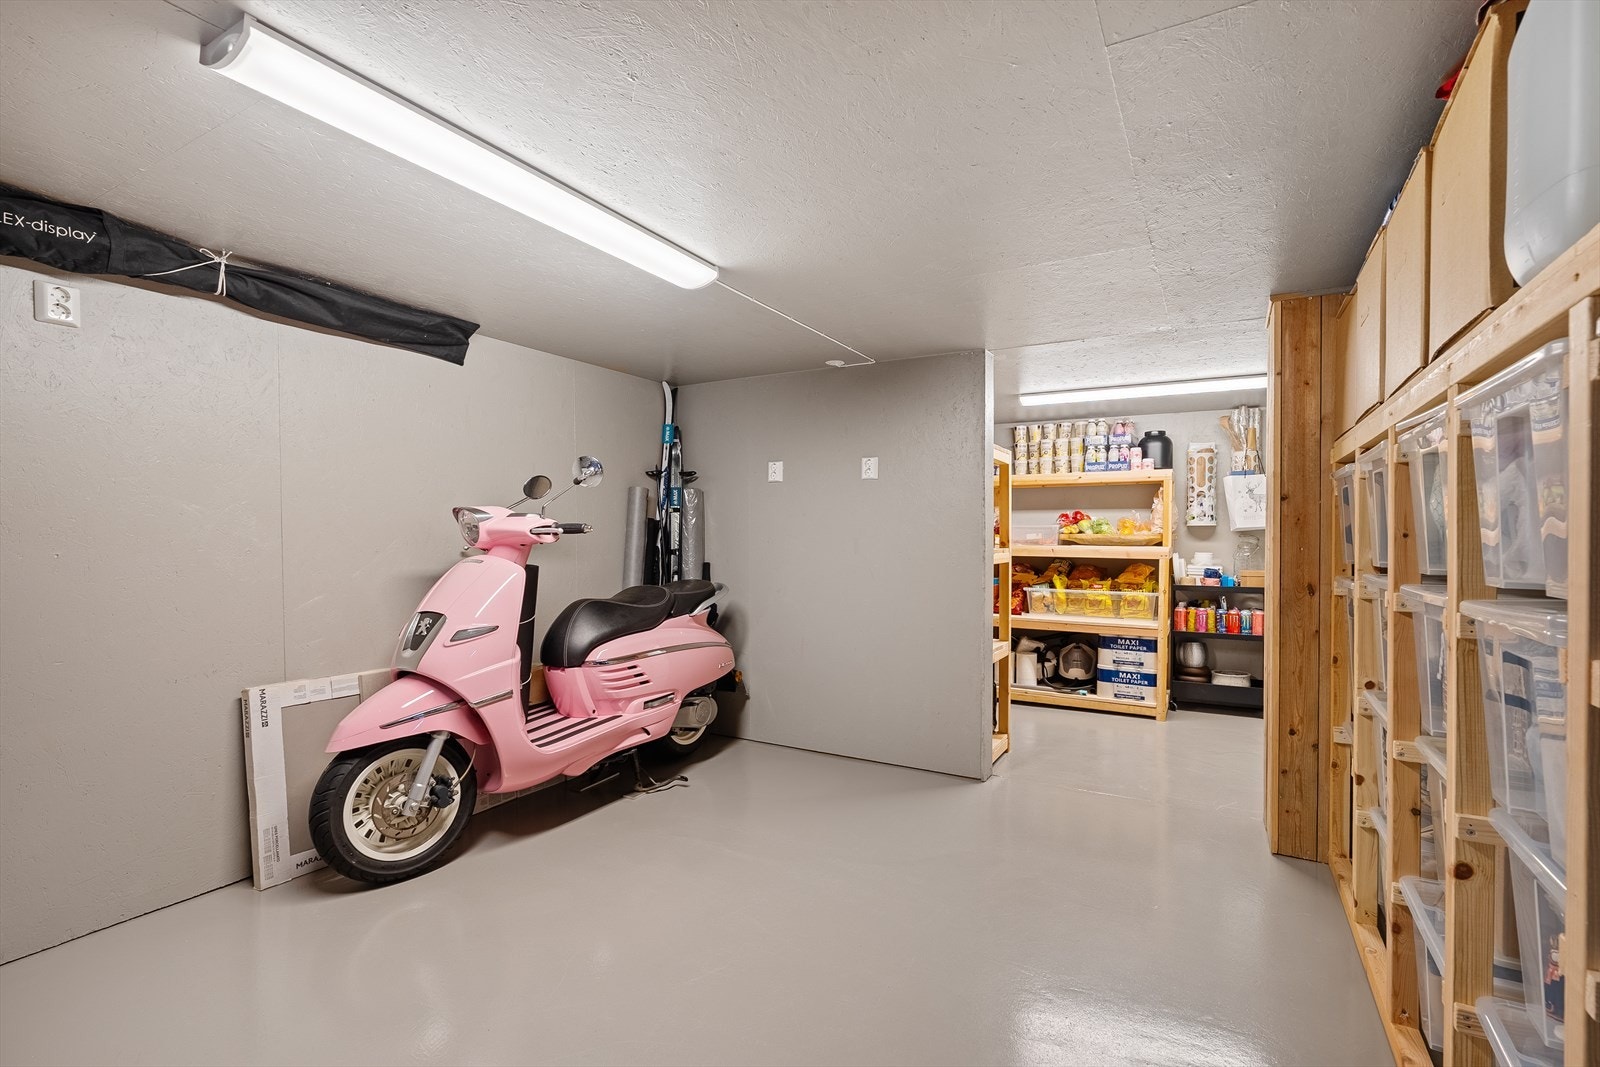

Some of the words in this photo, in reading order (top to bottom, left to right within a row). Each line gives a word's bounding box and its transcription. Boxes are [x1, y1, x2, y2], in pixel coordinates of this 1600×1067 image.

[1119, 672, 1141, 680] MAXI
[1130, 678, 1148, 686] PAPER
[259, 688, 269, 721] MARAZZI
